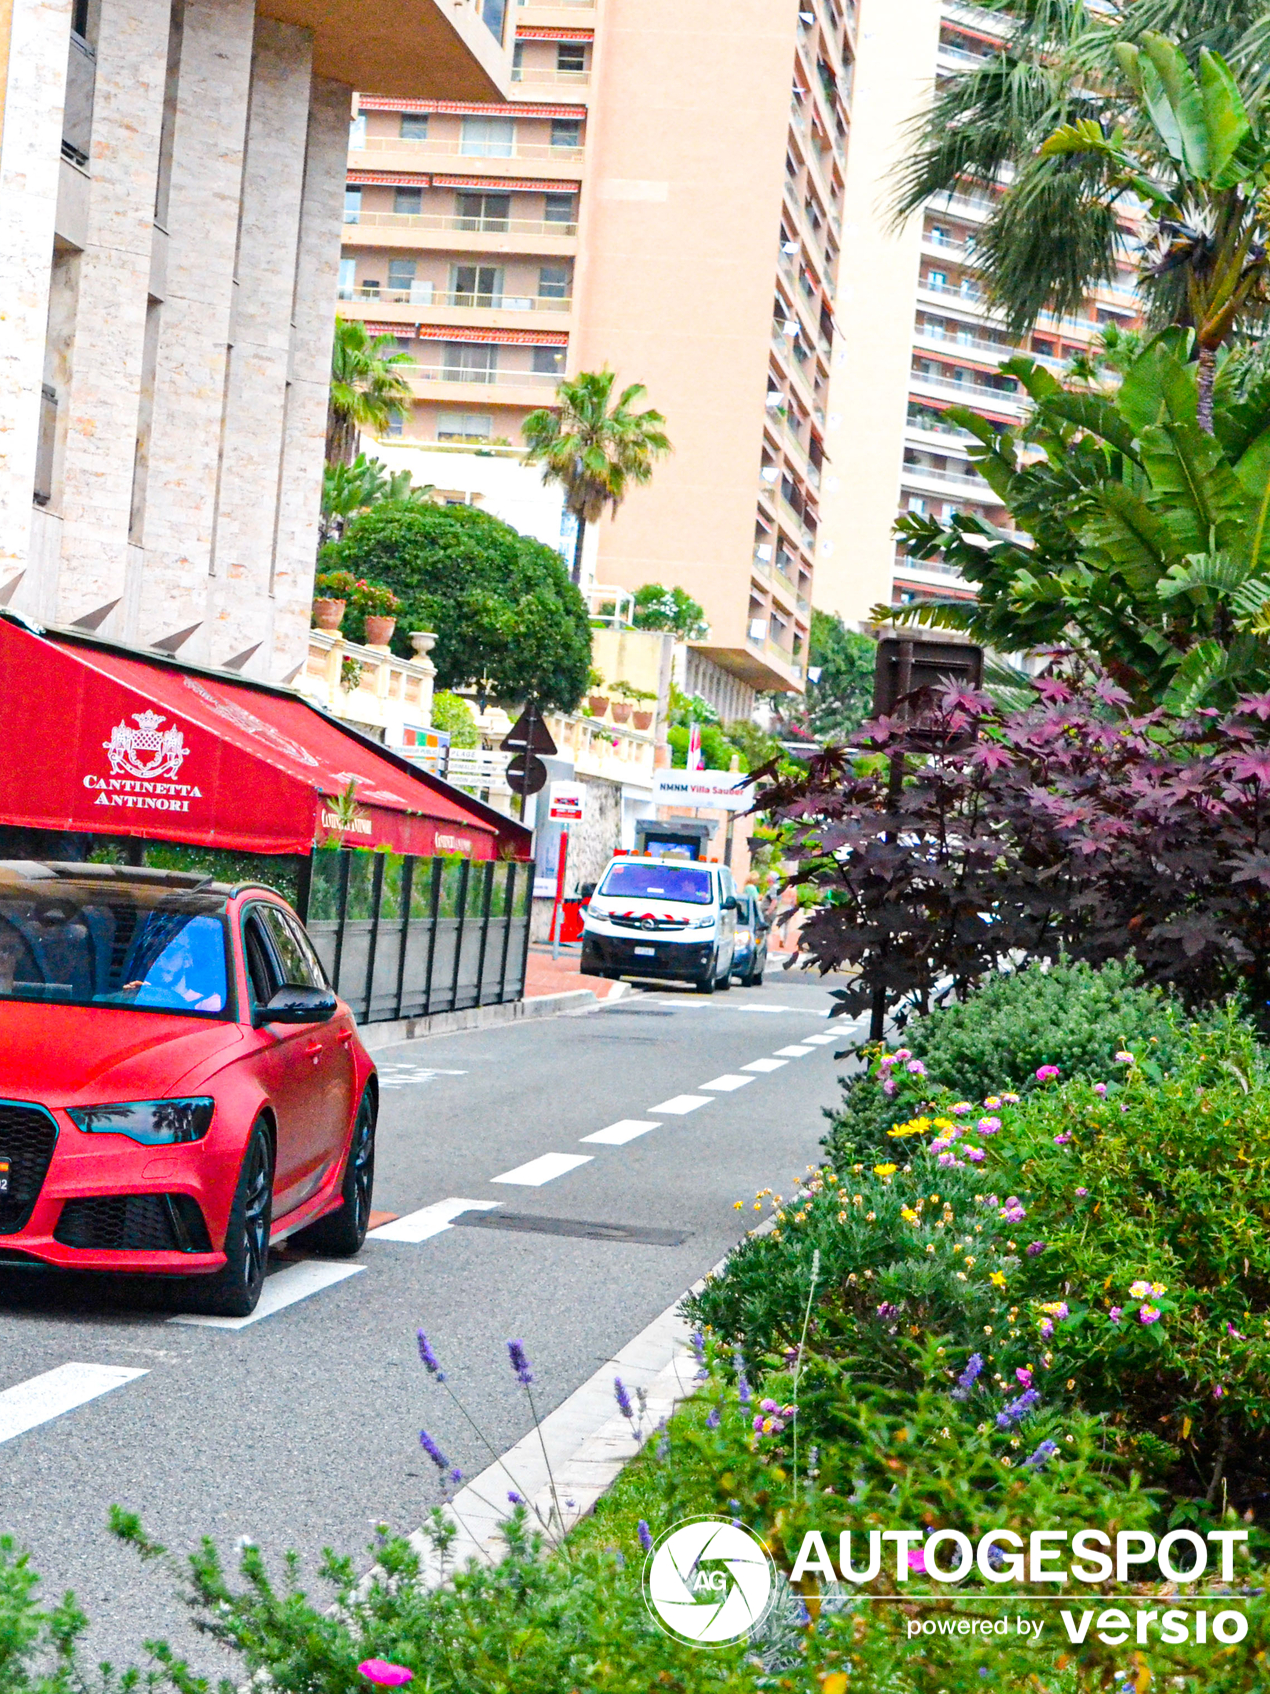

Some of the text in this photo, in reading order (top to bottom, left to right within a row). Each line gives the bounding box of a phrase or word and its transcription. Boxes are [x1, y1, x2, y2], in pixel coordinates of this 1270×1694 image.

[451, 750, 476, 758] PLAGE
[82, 774, 203, 798] CANTINETTA
[659, 783, 688, 792] NMNM
[690, 785, 710, 794] Villa
[93, 791, 190, 812] ANTINORI
